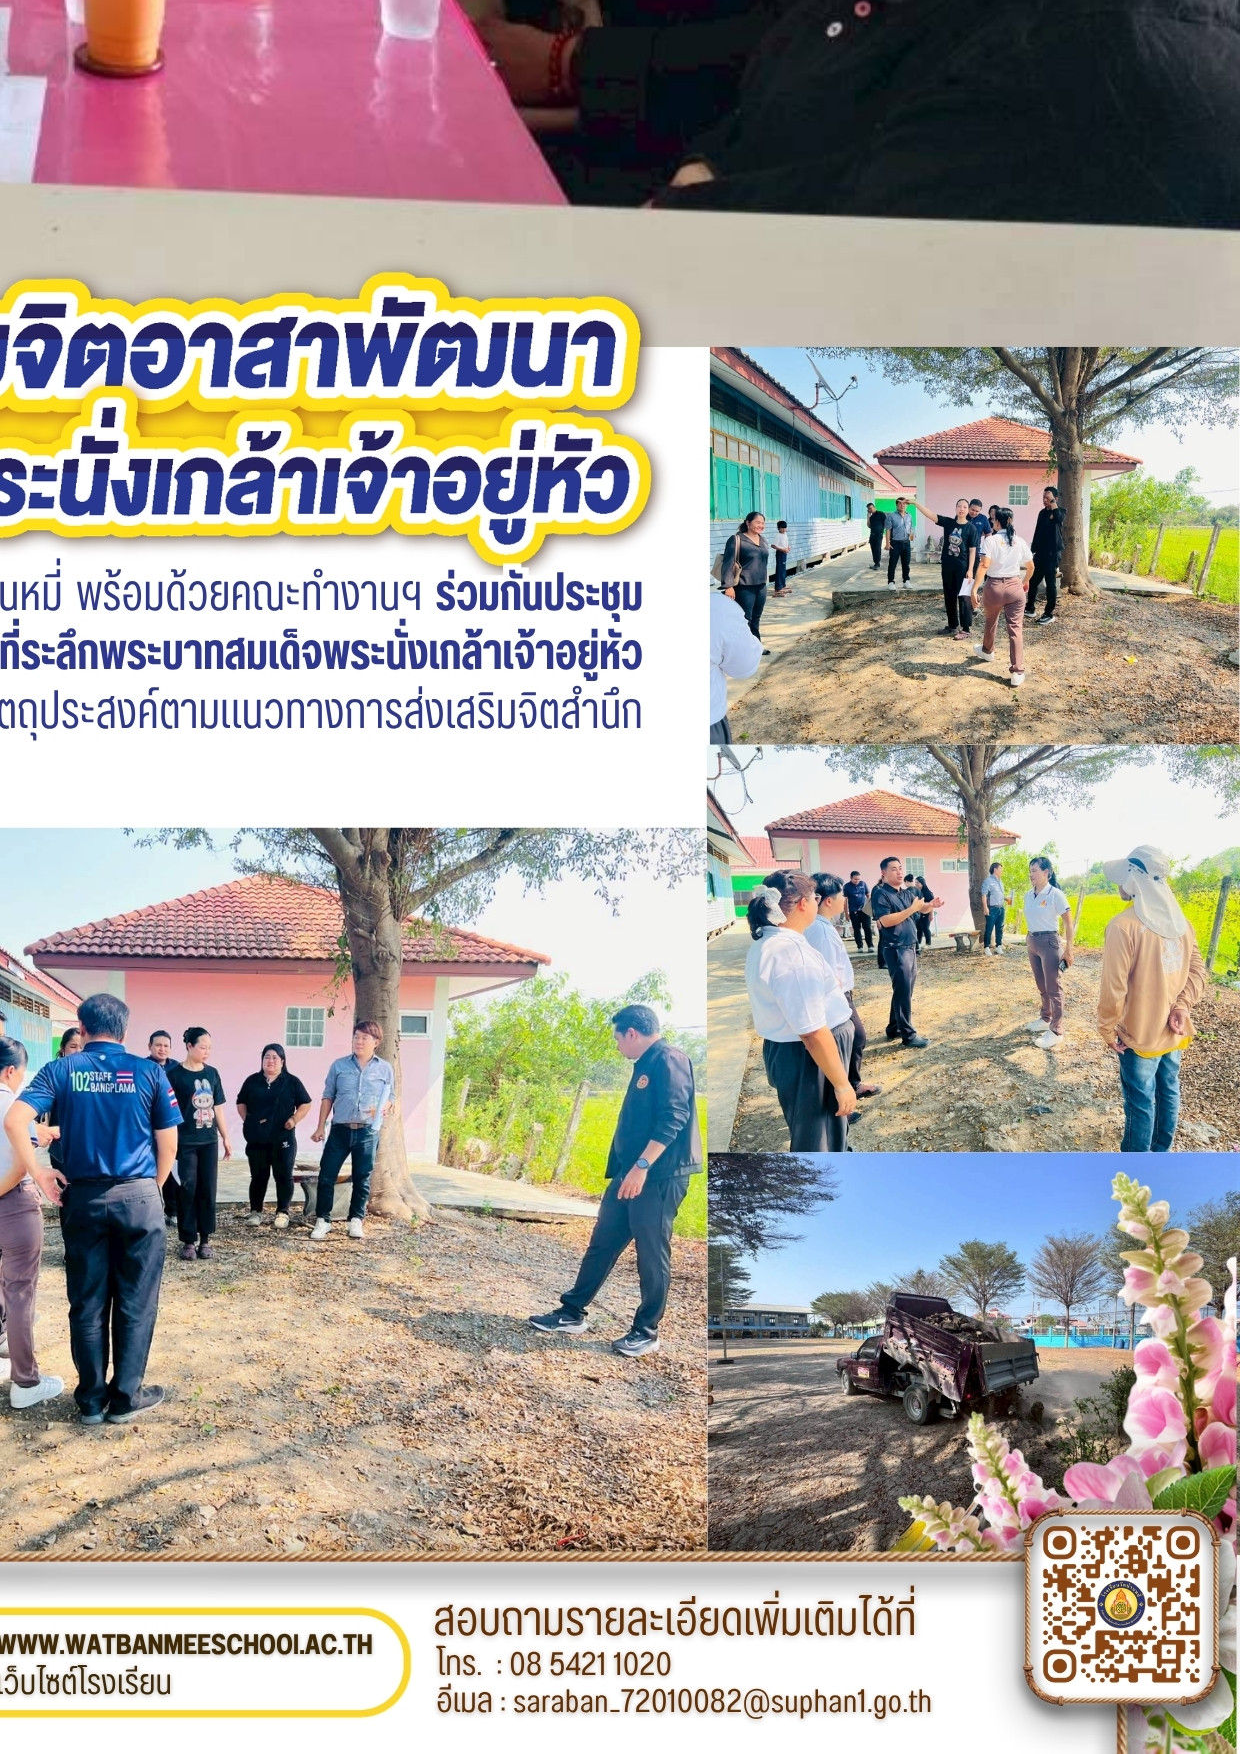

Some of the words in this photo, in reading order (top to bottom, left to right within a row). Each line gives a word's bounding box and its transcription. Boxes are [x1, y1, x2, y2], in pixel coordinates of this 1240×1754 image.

[71, 1071, 90, 1093] 102
[89, 1072, 113, 1082] STAFF
[90, 1082, 137, 1094] BANGPLAMA
